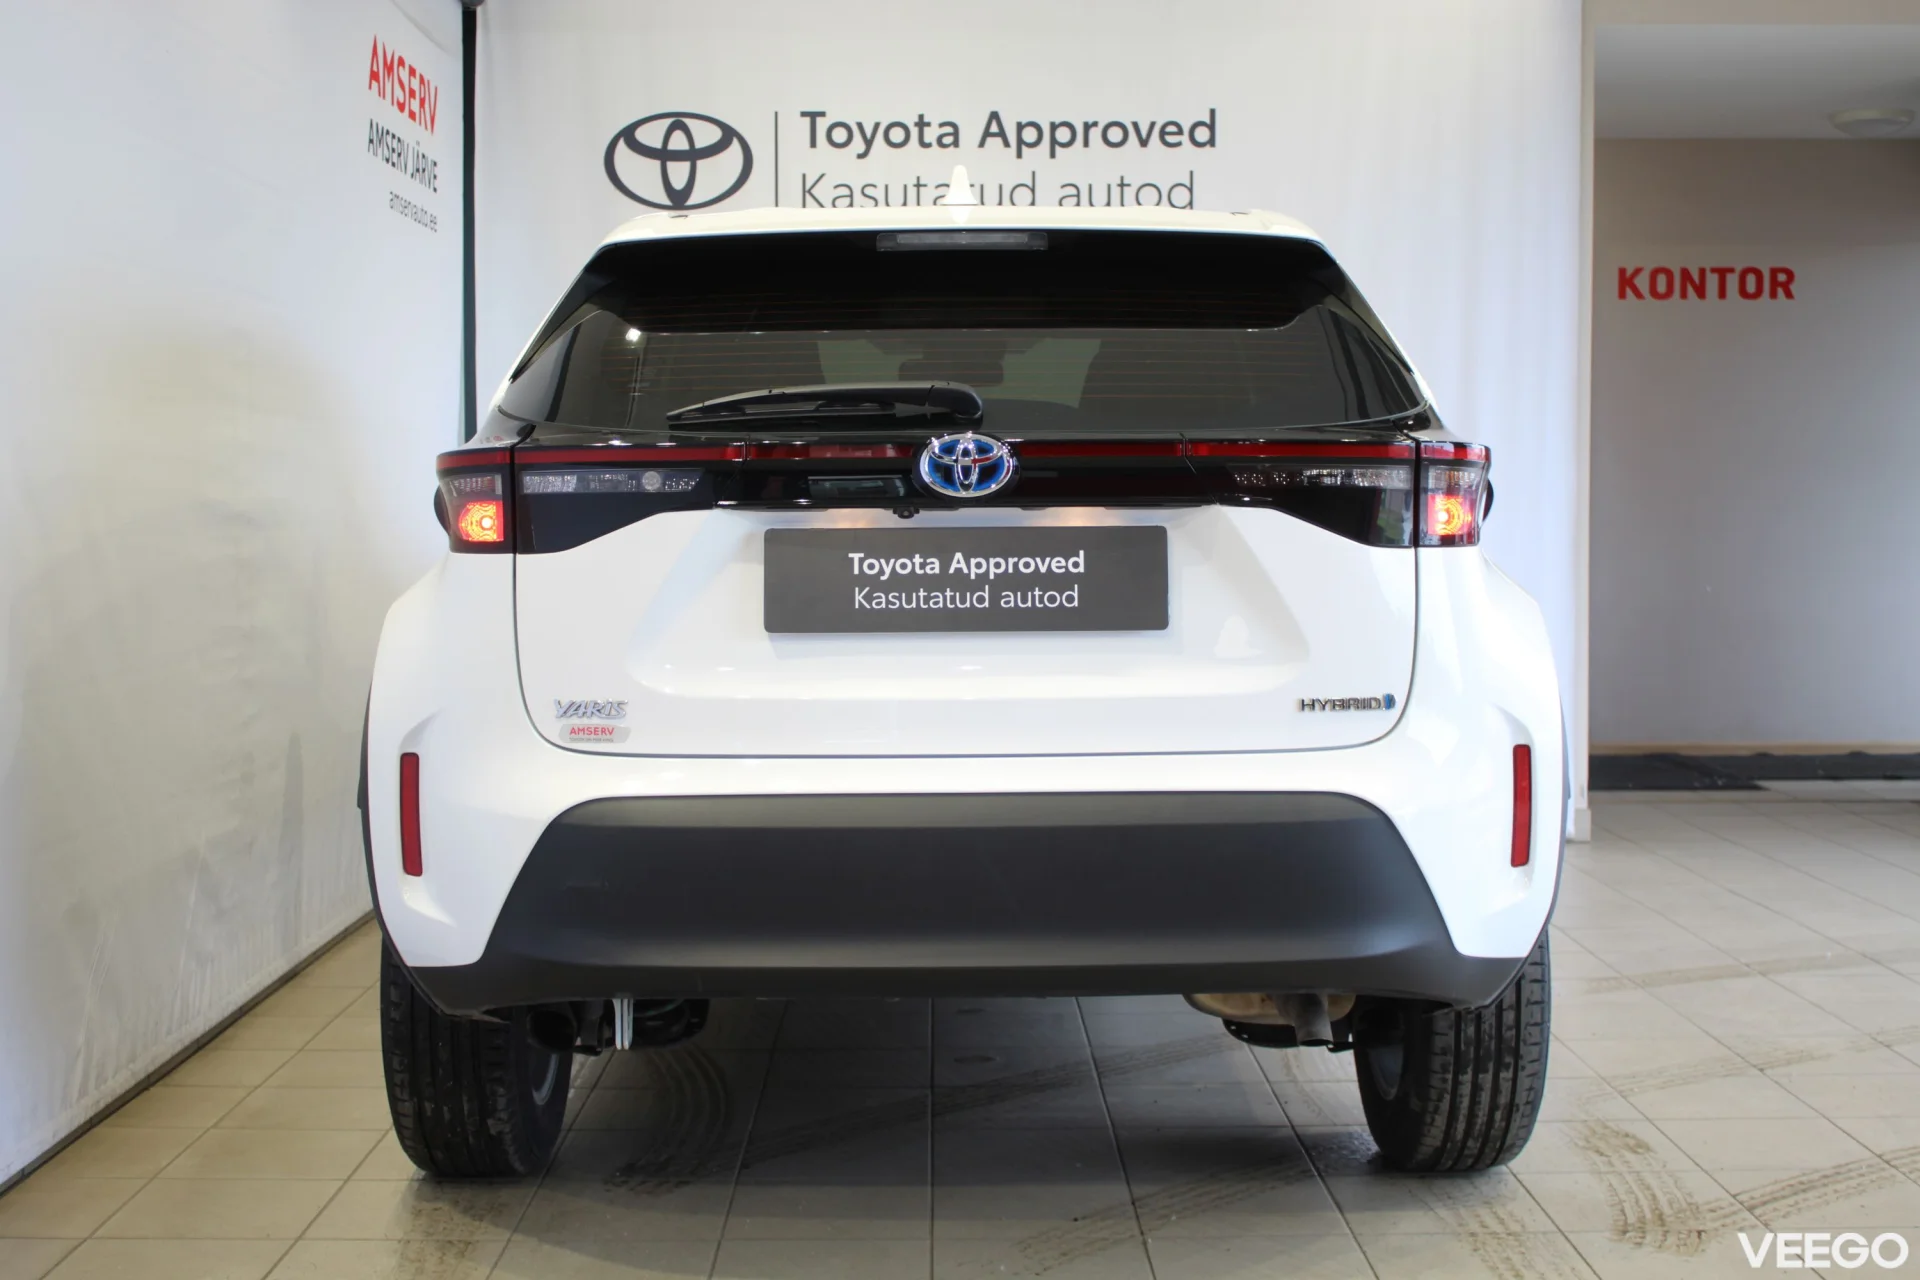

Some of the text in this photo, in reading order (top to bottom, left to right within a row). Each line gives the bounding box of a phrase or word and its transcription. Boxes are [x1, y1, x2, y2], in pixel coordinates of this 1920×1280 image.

[368, 34, 438, 135] AMSERV
[800, 107, 1217, 160] Toyota Approved
[368, 118, 438, 193] AMSERV JÄRVE
[801, 170, 1195, 209] Kasutaud autod
[389, 191, 438, 233] amservauto.ee
[1617, 266, 1796, 301] KONTOR
[848, 549, 1086, 581] Toyota Approved
[854, 583, 1080, 609] Kasutatud autod
[553, 698, 628, 720] YARIS
[1298, 697, 1382, 712] HYBRID
[569, 726, 615, 737] AMSERV
